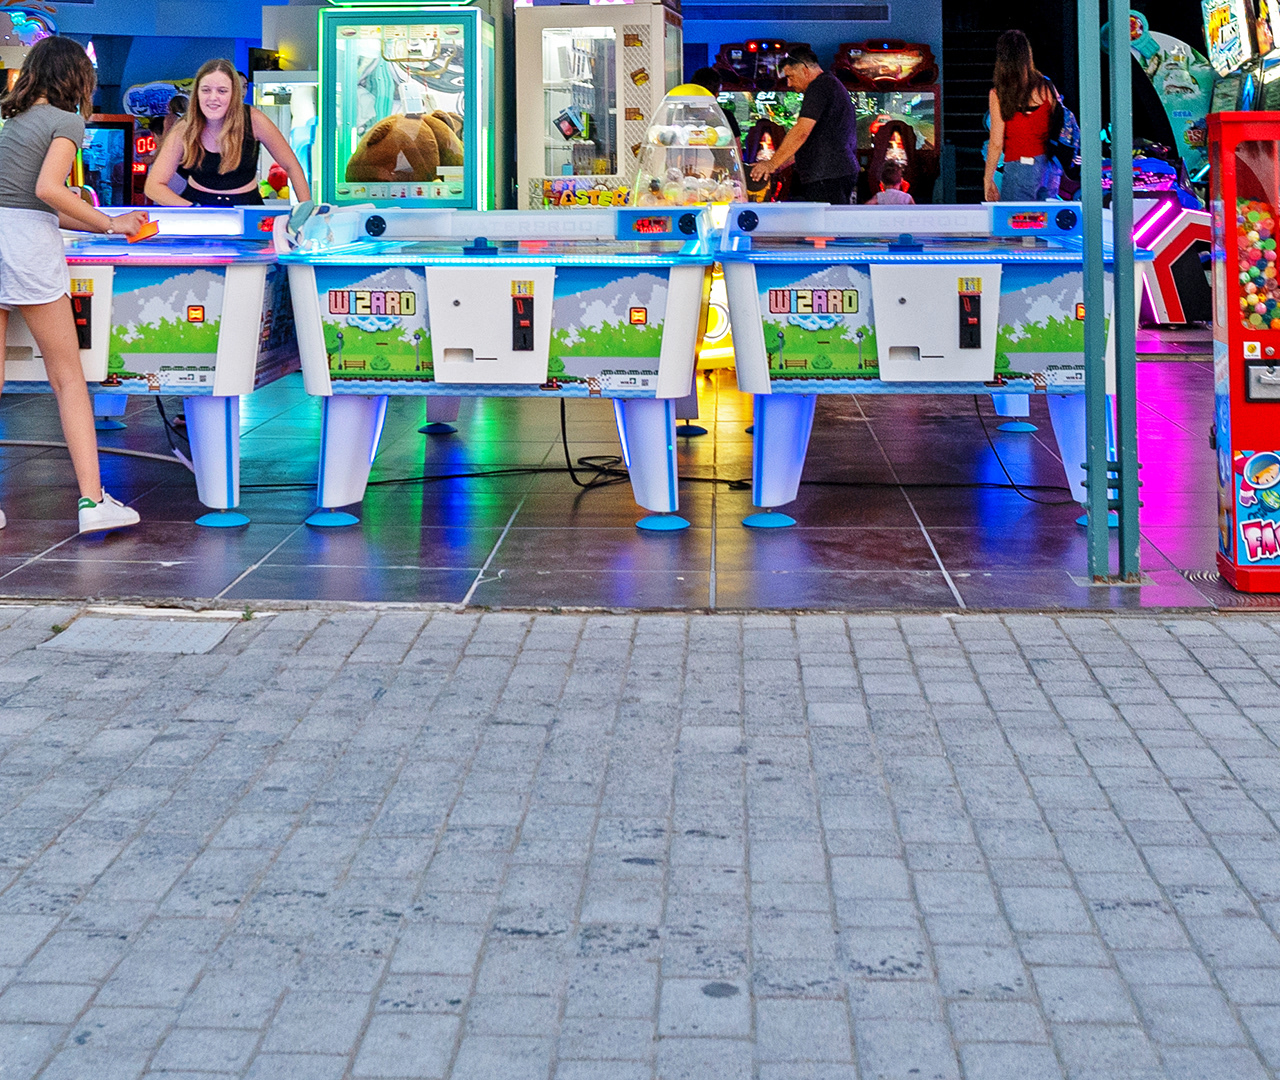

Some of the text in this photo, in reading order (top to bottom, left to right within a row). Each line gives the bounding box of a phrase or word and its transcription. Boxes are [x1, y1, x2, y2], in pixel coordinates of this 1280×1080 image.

[543, 180, 576, 192] KEY
[543, 189, 627, 207] MASTER
[329, 290, 416, 315] WIZARD
[769, 289, 858, 314] WIZARD
